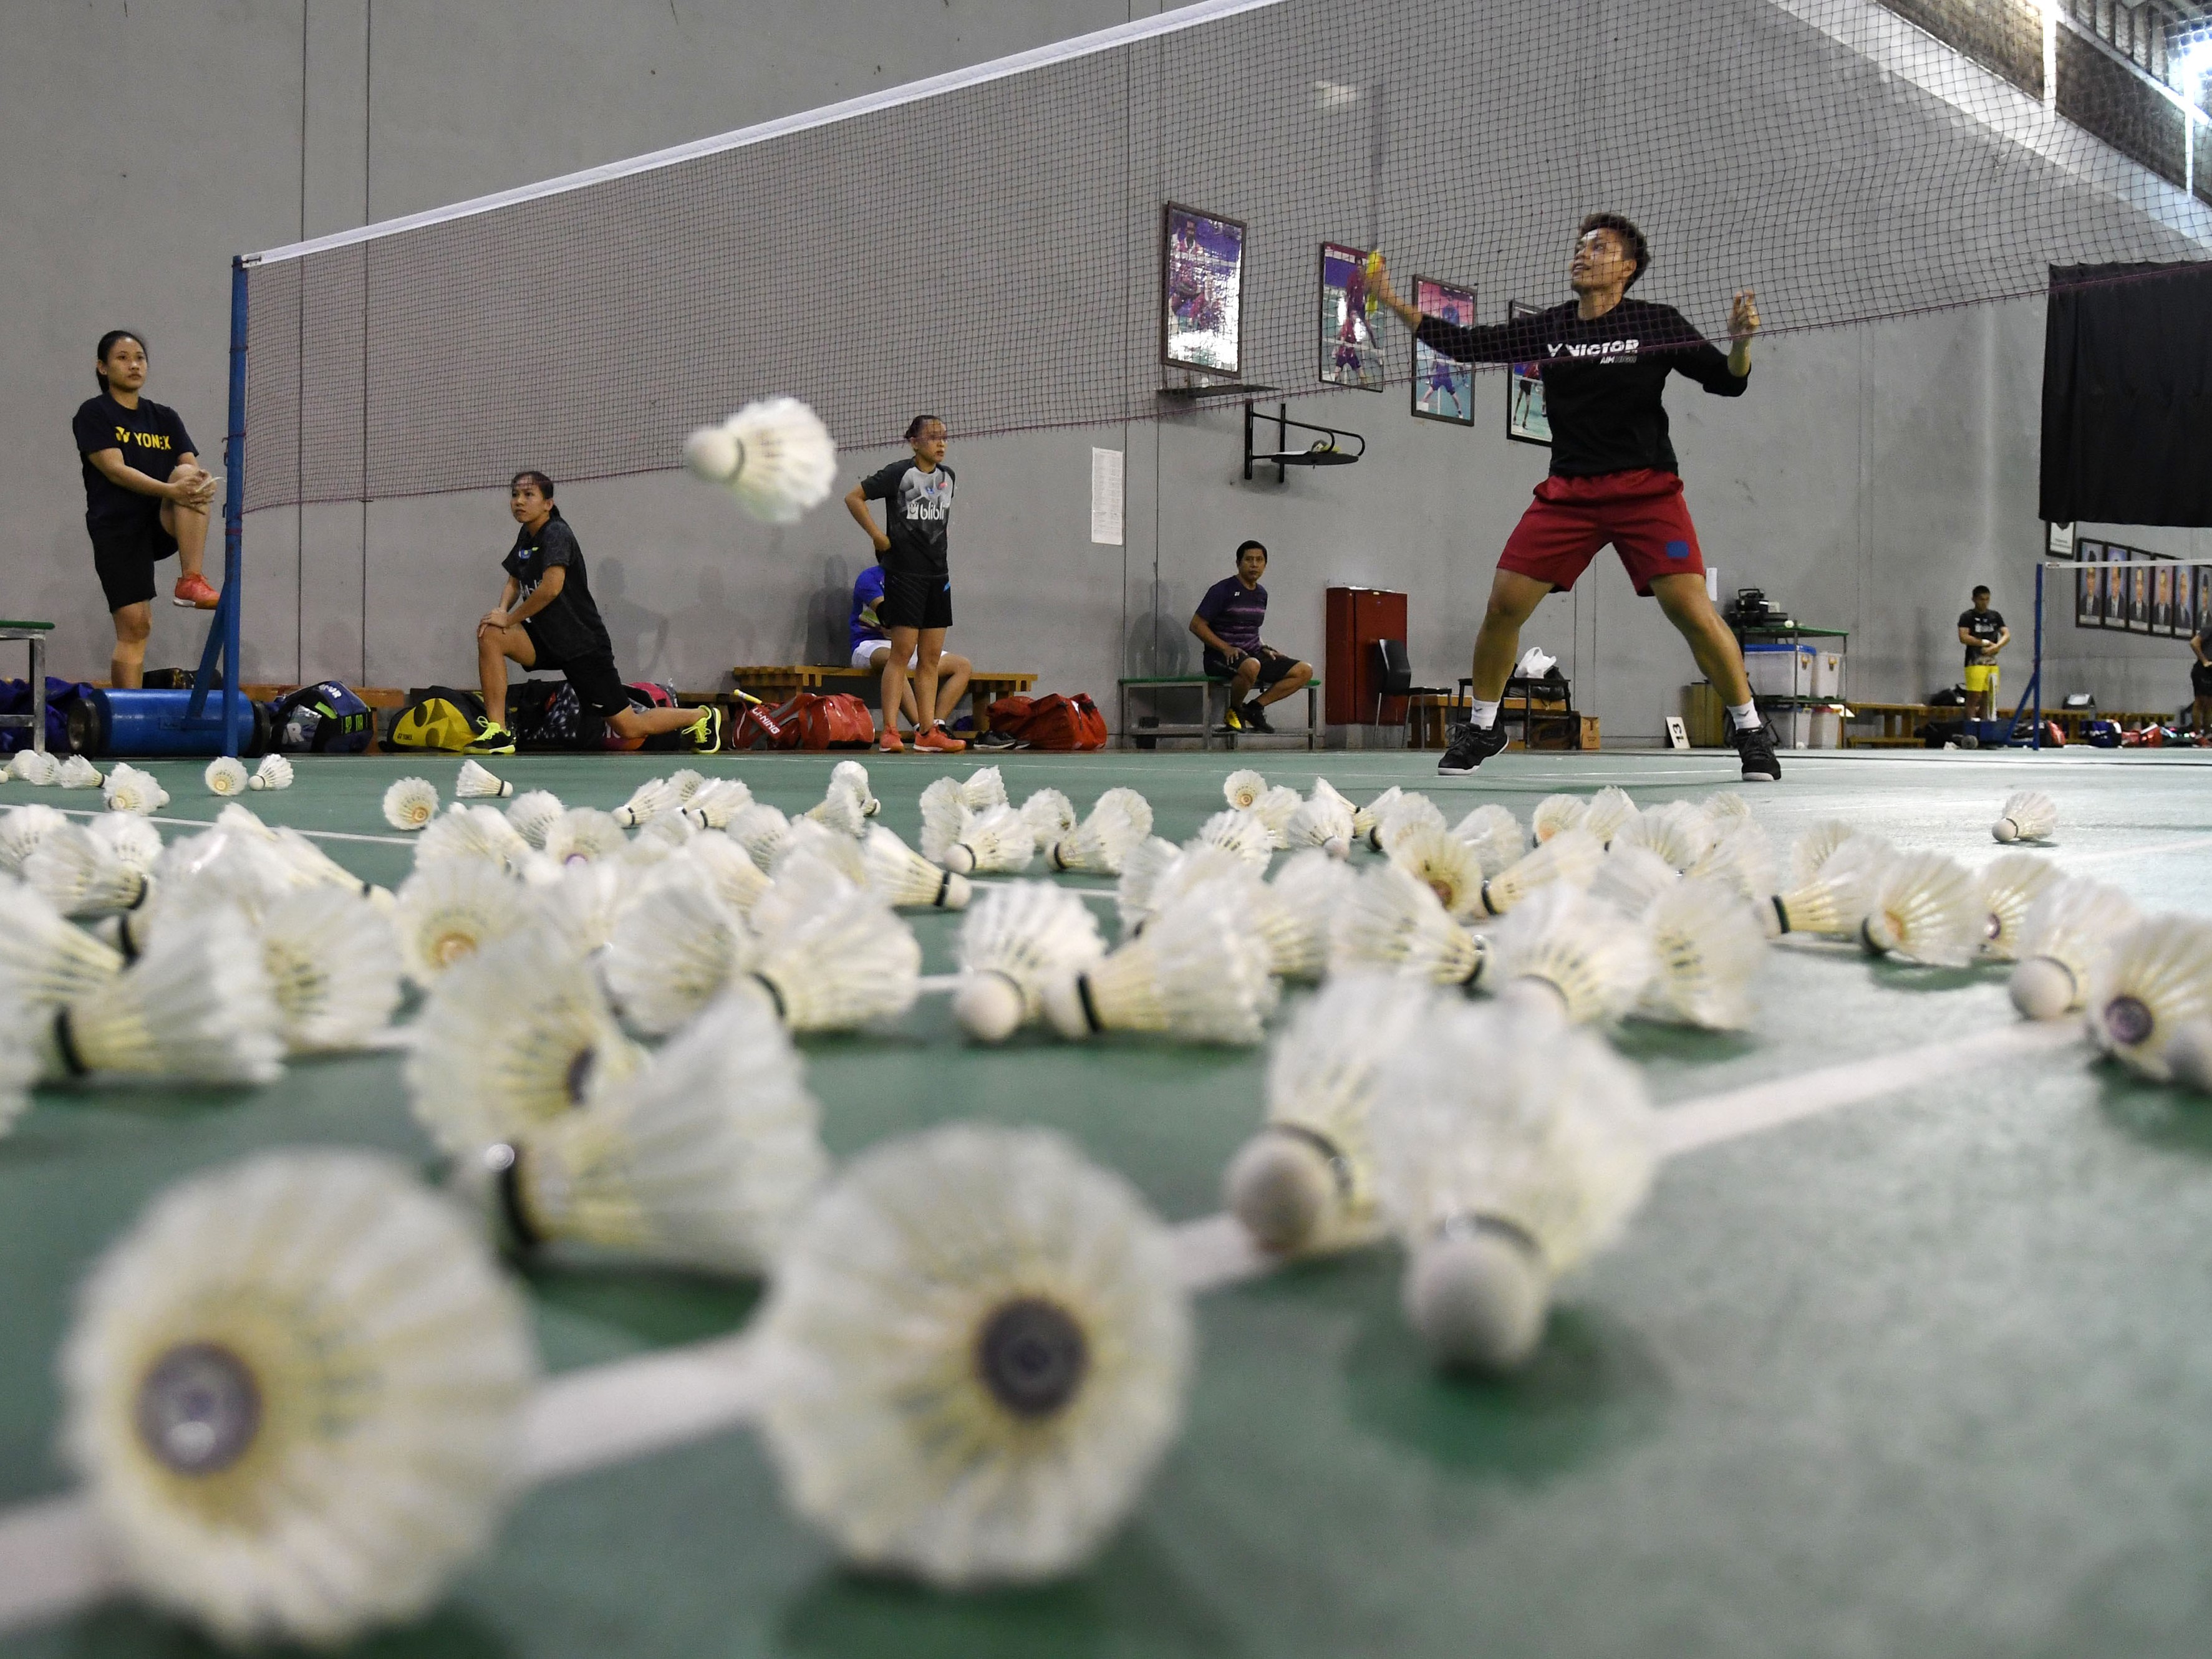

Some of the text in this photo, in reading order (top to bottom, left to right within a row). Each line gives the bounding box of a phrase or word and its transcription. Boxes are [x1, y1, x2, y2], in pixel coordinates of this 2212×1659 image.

[1565, 339, 1640, 357] VICTOR
[133, 431, 171, 450] YONEX
[920, 501, 944, 520] blibli
[752, 707, 780, 734] LI-NING
[1673, 724, 1684, 743] 13
